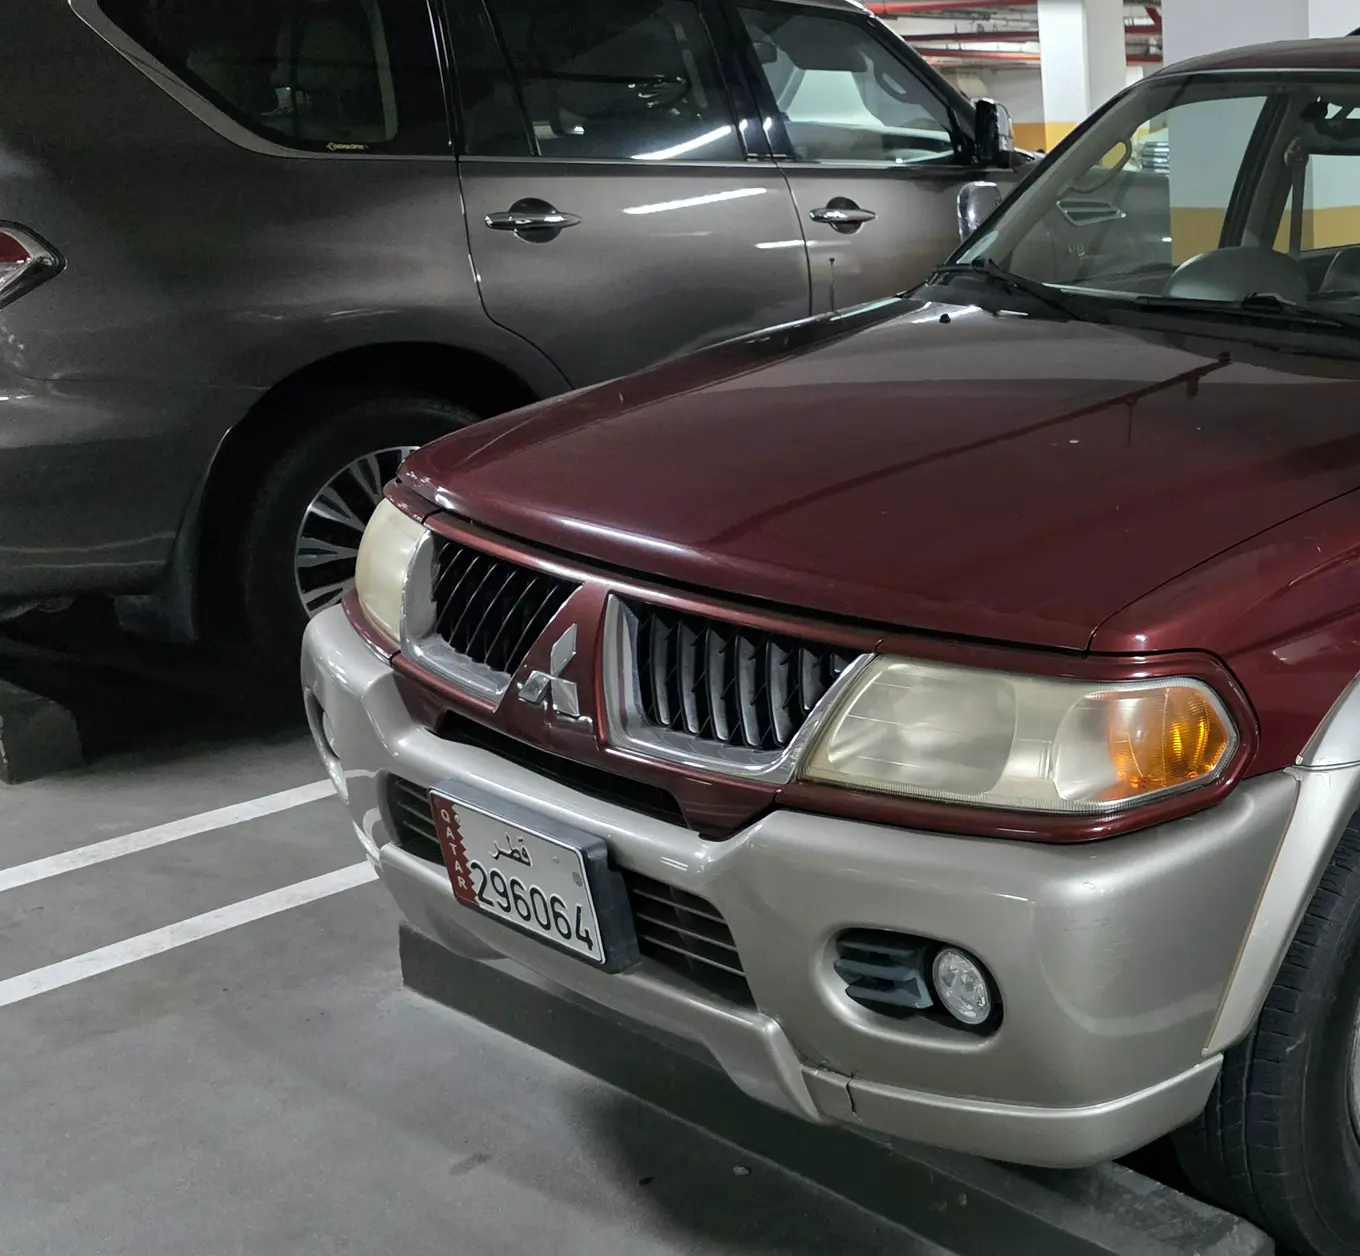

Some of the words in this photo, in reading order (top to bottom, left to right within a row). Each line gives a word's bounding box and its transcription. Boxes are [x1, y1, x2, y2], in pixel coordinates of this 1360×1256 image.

[440, 808, 468, 890] QATAR
[489, 832, 534, 868] قطر
[469, 859, 594, 952] 296064
